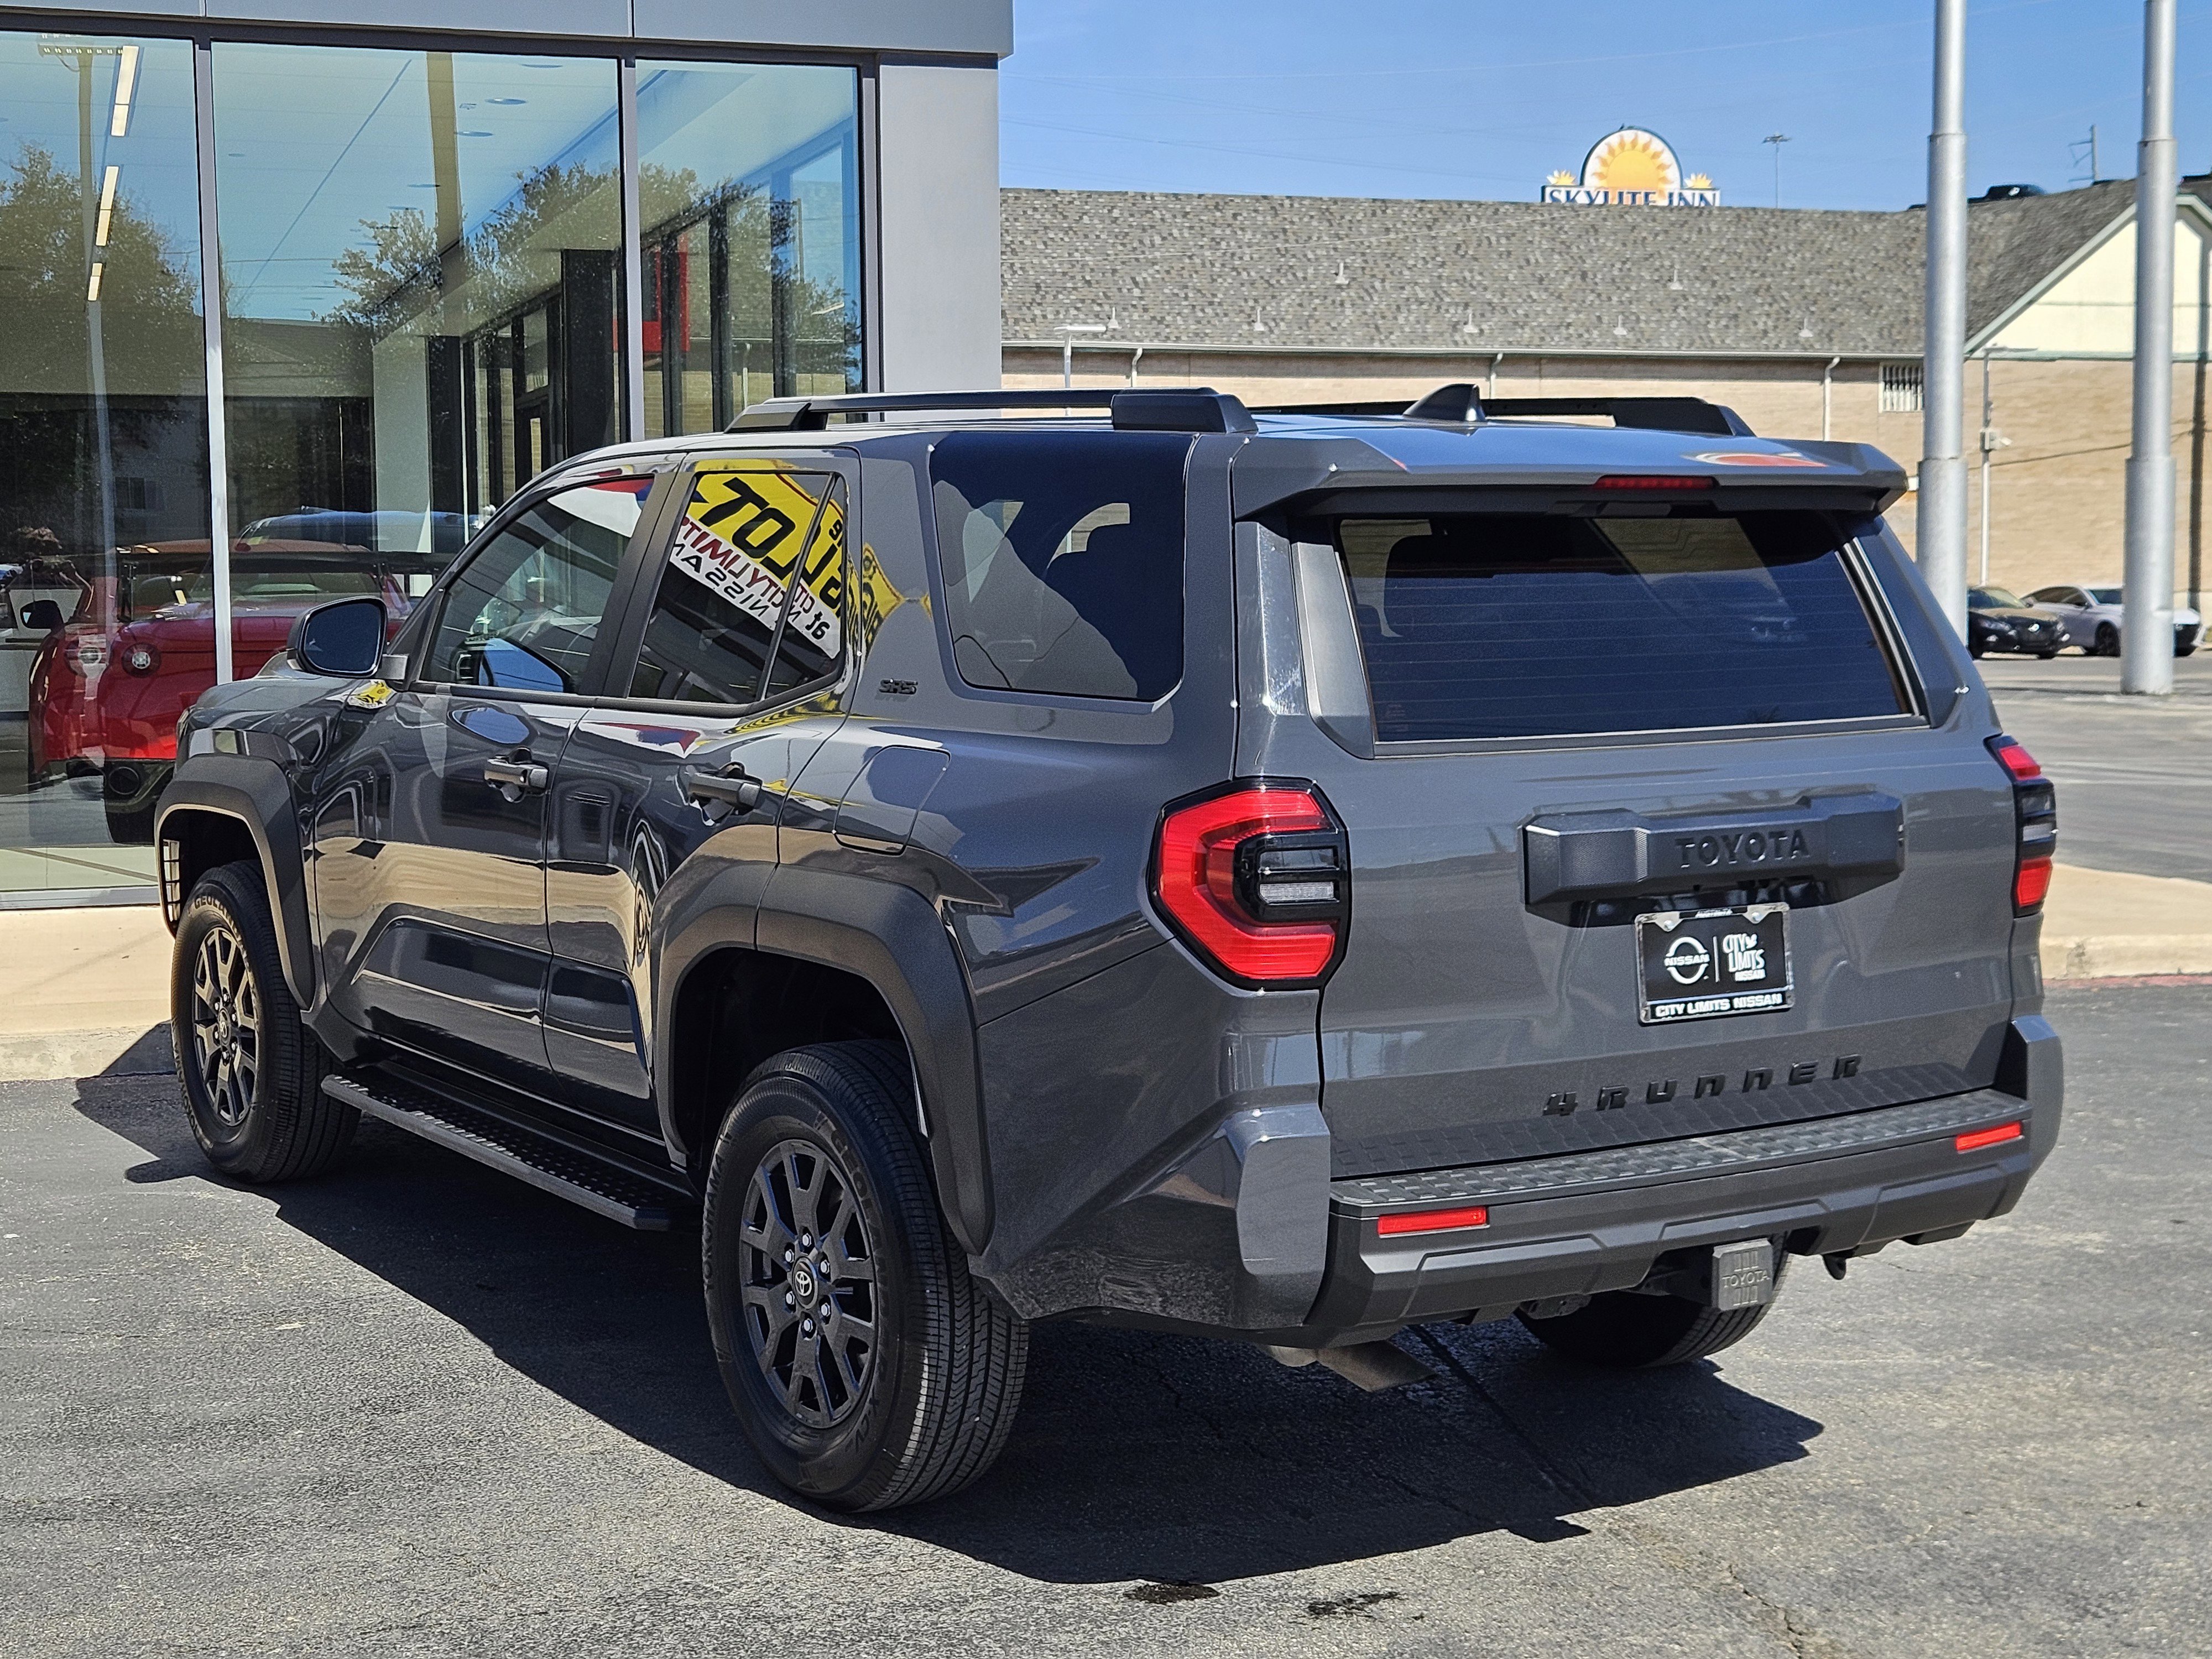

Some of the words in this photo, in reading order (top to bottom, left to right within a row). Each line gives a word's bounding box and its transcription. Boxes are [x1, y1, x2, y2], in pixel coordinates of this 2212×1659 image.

[1549, 189, 1656, 205] SKYLITE
[1667, 191, 1716, 206] INN
[878, 678, 919, 695] SR5
[1674, 829, 1810, 868] TOYOTA
[1664, 953, 1710, 967] NISSAN
[1728, 949, 1765, 973] LIMITS
[1655, 1003, 1686, 1018] CITY
[1687, 998, 1731, 1014] LIMITS
[1733, 993, 1783, 1009] NISSAN
[1542, 1053, 1862, 1116] 4RUNNER
[1721, 1270, 1771, 1288] TOYOTA
